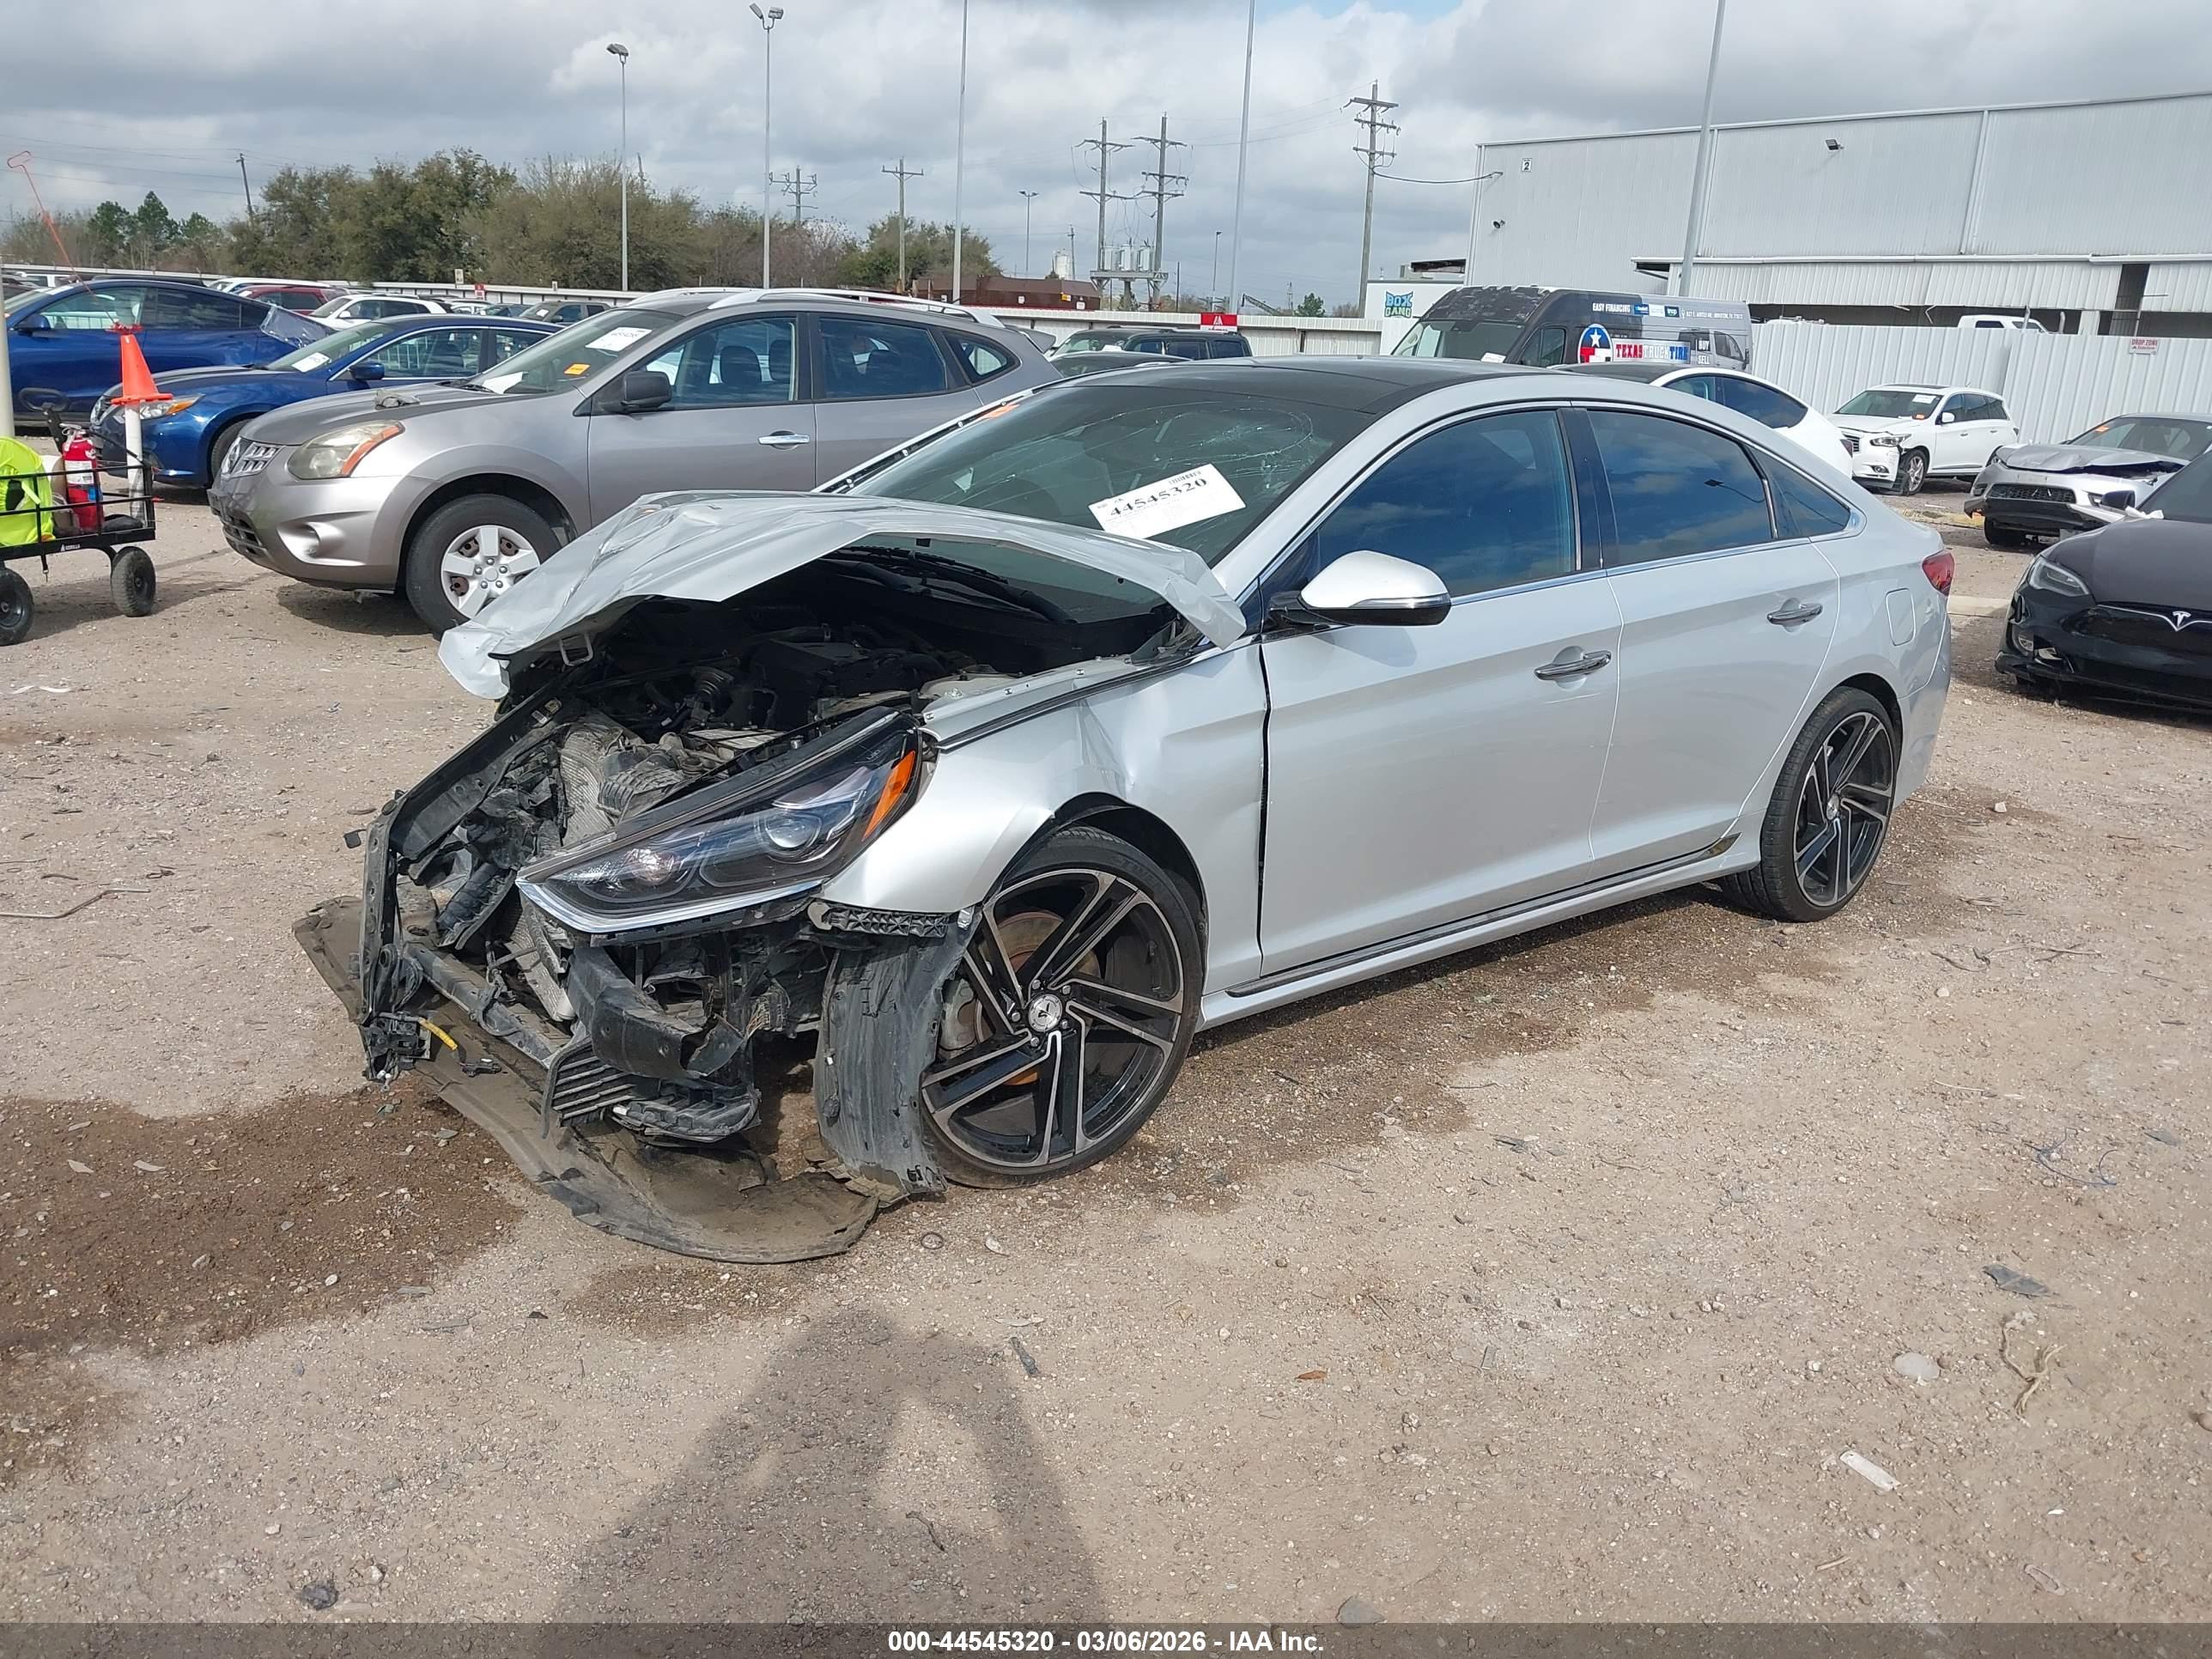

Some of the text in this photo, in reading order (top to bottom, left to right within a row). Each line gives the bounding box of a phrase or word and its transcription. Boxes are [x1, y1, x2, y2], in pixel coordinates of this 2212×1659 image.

[1524, 161, 1529, 170] 2
[1385, 291, 1413, 307] BOX
[1384, 306, 1412, 318] GANG
[1593, 302, 1605, 312] EASY
[1606, 303, 1631, 313] FINANCING
[1698, 340, 1710, 350] BUY
[1698, 355, 1711, 365] SELL
[1110, 478, 1207, 515] 44545320
